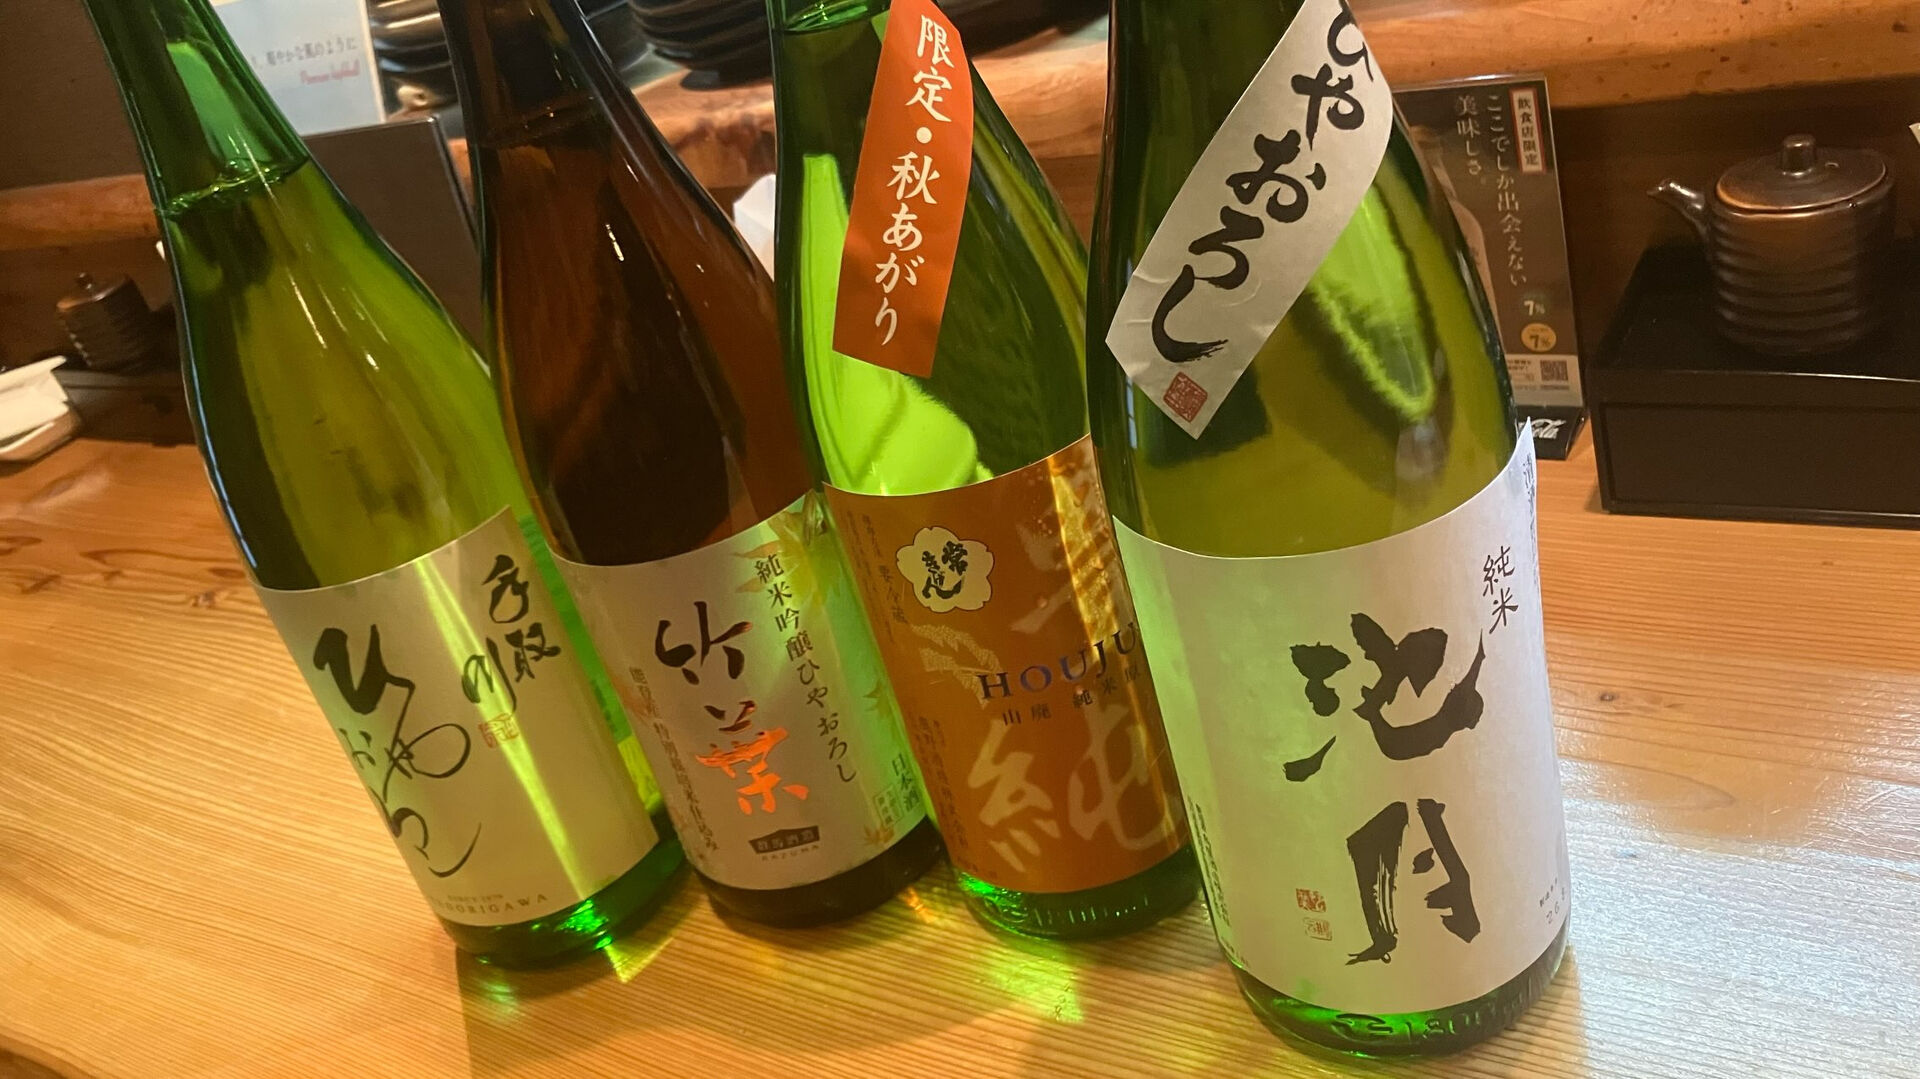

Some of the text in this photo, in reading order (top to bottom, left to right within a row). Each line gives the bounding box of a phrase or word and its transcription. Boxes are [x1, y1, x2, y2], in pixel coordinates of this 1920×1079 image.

[1487, 95, 1528, 287] ここでしか出会えない
[1518, 97, 1539, 165] 飲食店限定
[1482, 546, 1519, 634] 純米
[754, 554, 857, 783] 純米吟醸ひやおろし
[976, 622, 1137, 700] HOUJU
[1282, 613, 1486, 966] 池月
